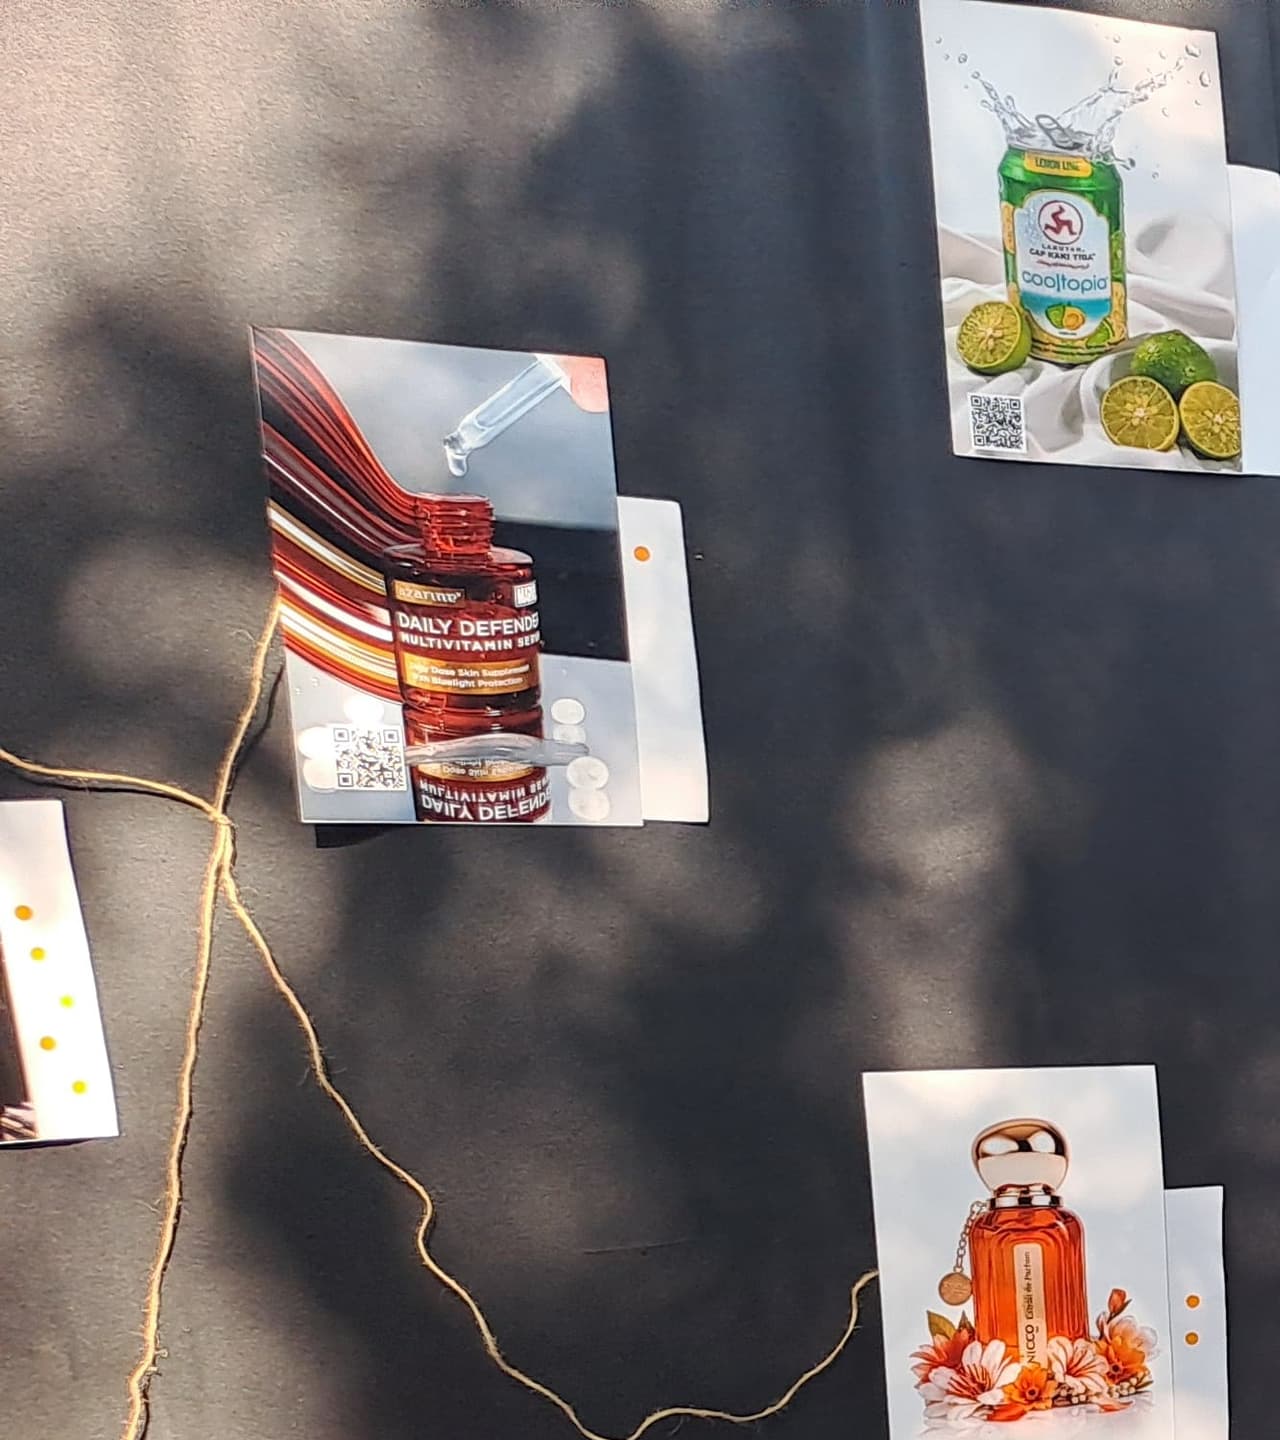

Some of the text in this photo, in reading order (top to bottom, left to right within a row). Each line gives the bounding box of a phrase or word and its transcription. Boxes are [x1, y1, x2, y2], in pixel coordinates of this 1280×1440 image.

[1022, 270, 1108, 294] cooltopia
[398, 611, 453, 635] DAILY
[400, 632, 513, 651] MULTIVITAMIN
